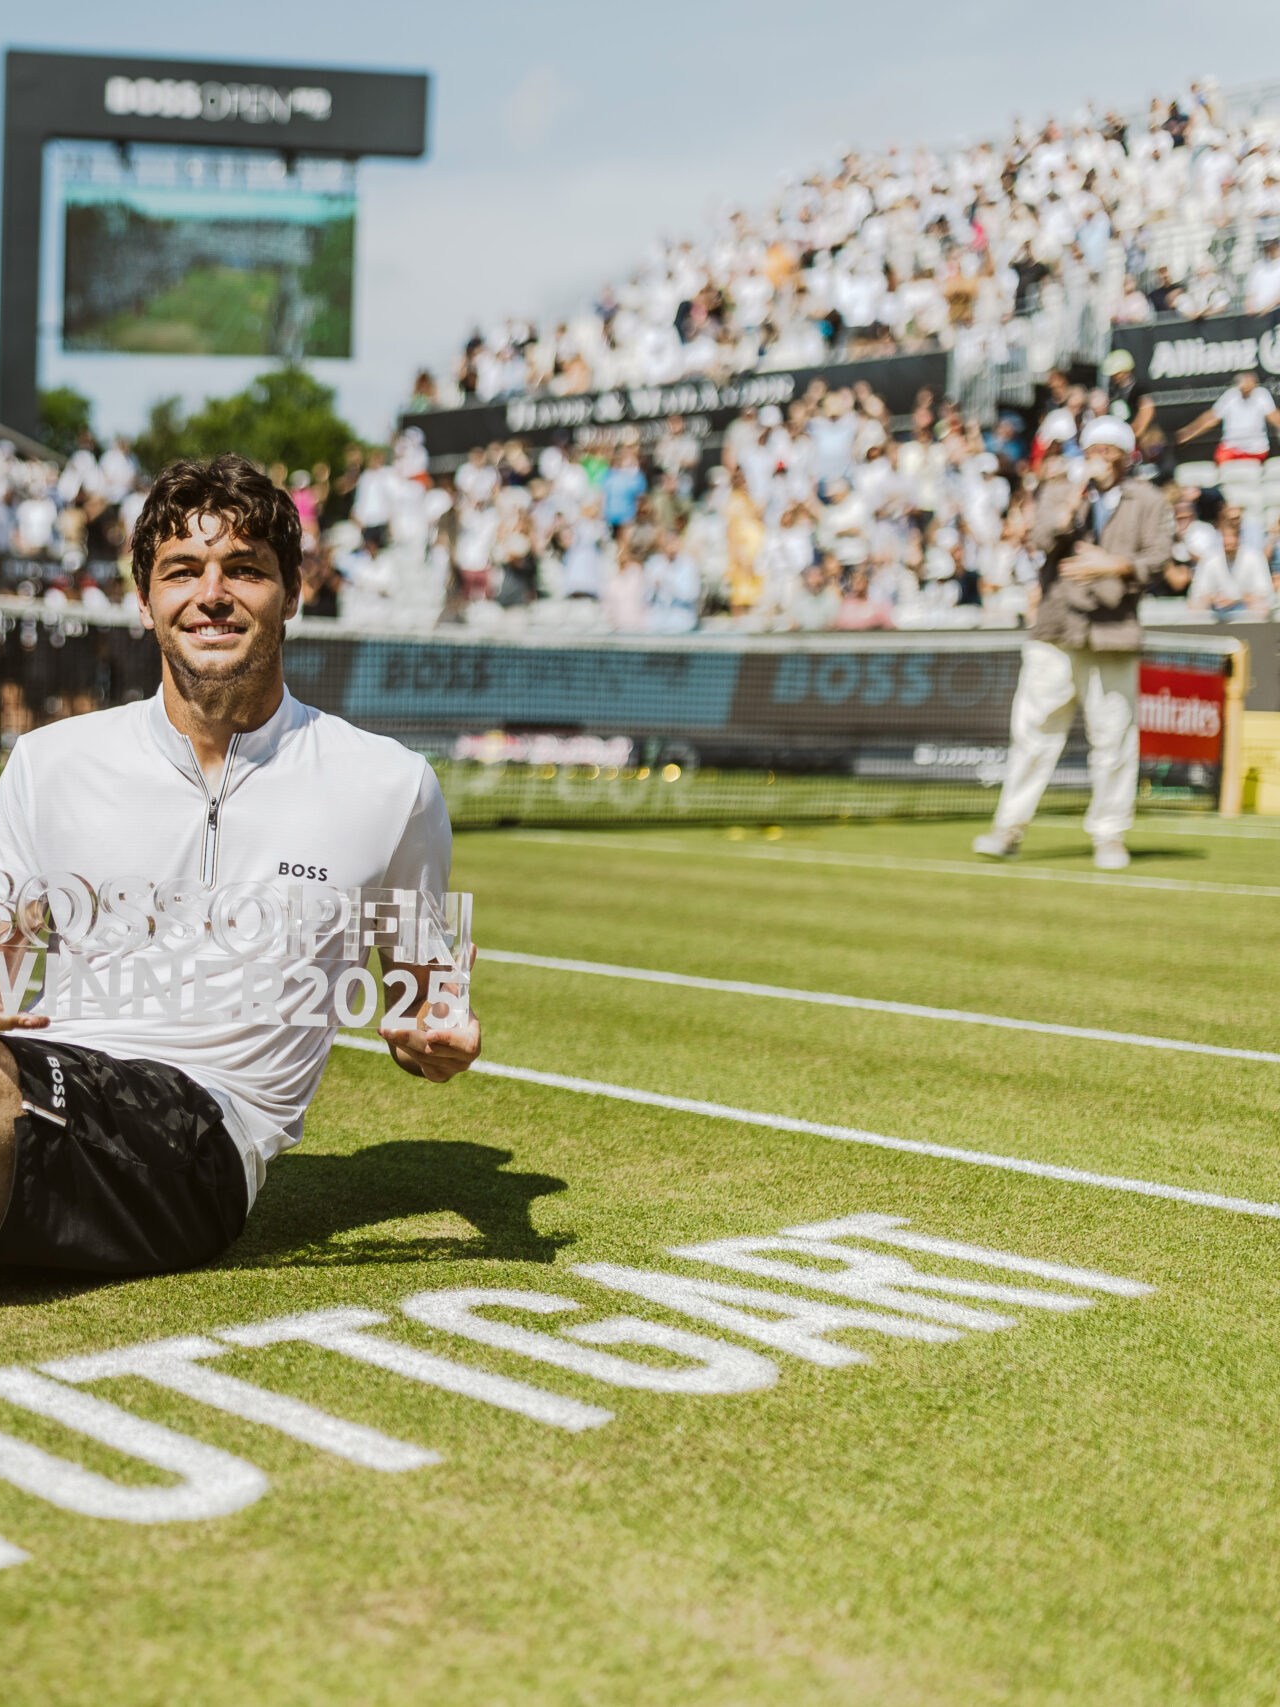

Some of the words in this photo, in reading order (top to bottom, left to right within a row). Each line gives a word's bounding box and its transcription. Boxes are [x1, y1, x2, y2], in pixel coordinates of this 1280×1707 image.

[1148, 337, 1259, 380] Allianz
[773, 652, 936, 706] BOSS
[1139, 686, 1221, 738] mirates
[278, 861, 328, 882] BOSS
[46, 1055, 66, 1109] BOSS
